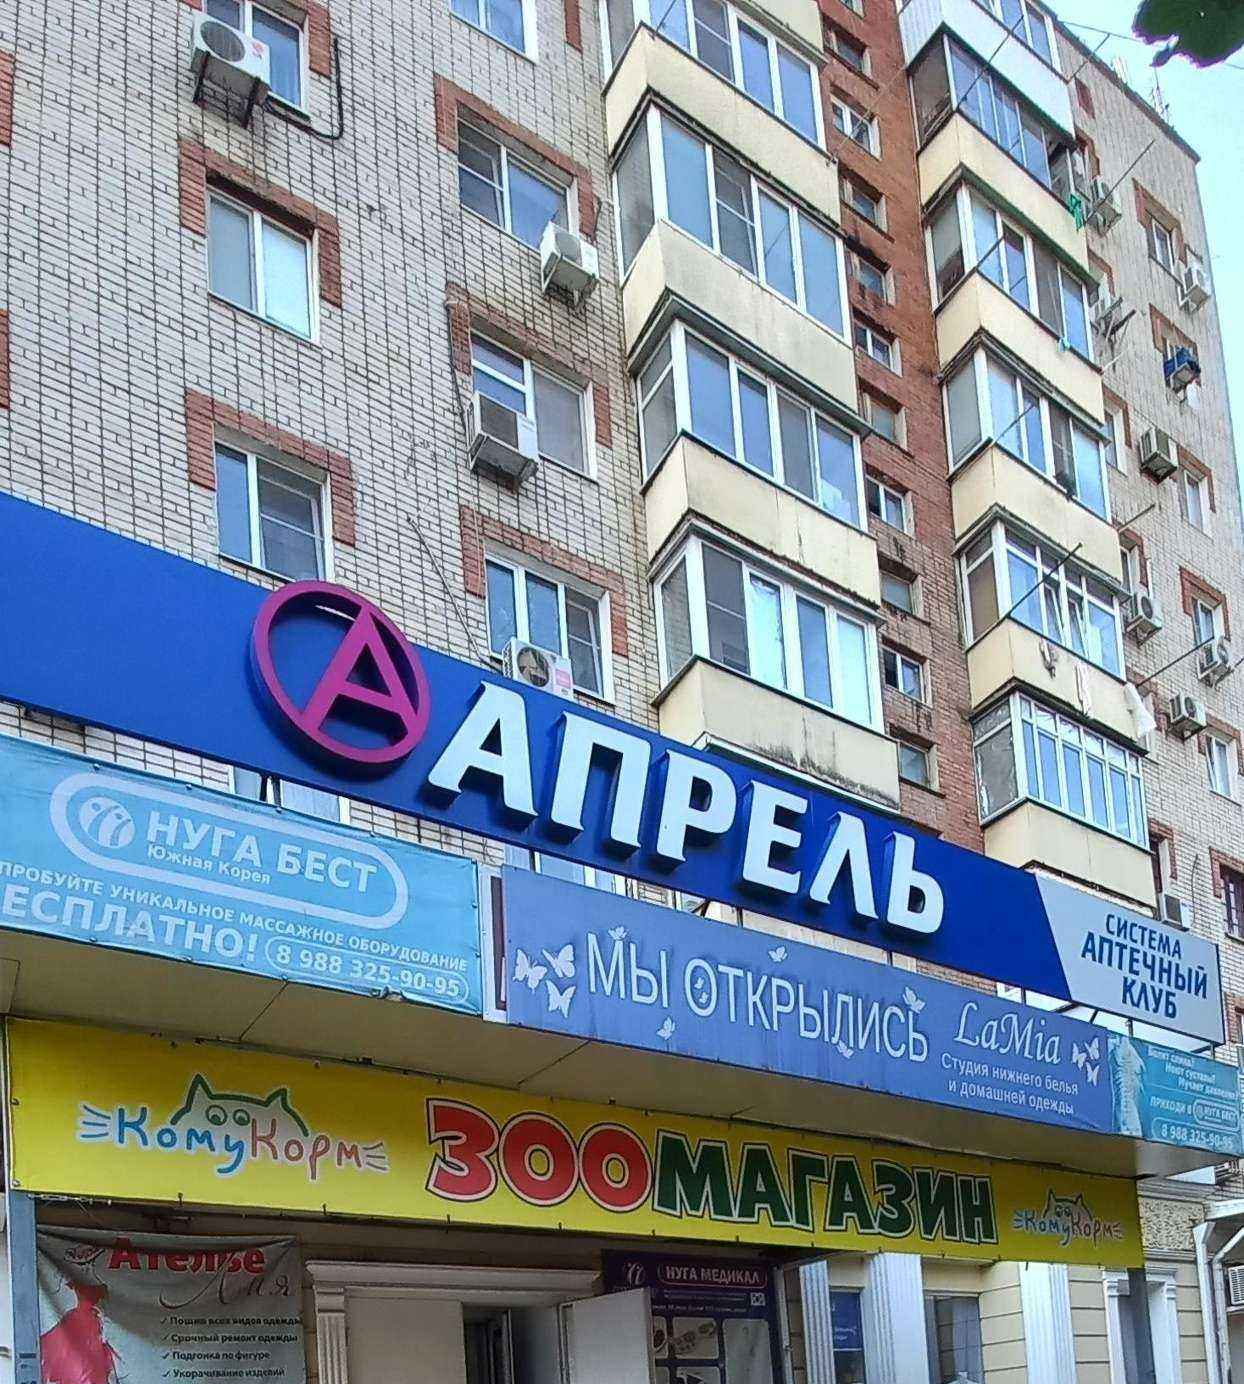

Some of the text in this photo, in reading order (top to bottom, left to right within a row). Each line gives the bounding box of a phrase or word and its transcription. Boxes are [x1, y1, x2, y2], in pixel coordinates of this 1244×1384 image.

[427, 680, 945, 936] АПРЕЛЬ
[147, 810, 378, 893] НУГА БЕСТ
[148, 843, 272, 886] Южная Корея
[110, 884, 236, 921] УНИКАЛЬНОЕ
[240, 913, 344, 945] МАССАЖНОЕ
[349, 935, 468, 972] ОБОРУДОВАНИЕ
[1105, 913, 1182, 960] СИСТЕМА
[275, 944, 461, 998] 8 988 325-90-95
[1081, 931, 1208, 1000] АПТЕЧНЫЙ
[586, 930, 929, 1063] МЫ ОТКРЫЛИСЬ
[1121, 975, 1178, 1019] КЛУБ
[941, 1052, 1079, 1096] Студия нижнего белья
[948, 1079, 1074, 1116] и домашней одежды
[116, 1105, 363, 1181] КомуКорм
[425, 1097, 998, 1245] ЗООМАГАЗИН
[107, 1237, 266, 1274] Ателье
[665, 1264, 761, 1284] НУГА МЕДИКАЛ
[171, 1333, 298, 1344] Срочный ремонт одежды
[172, 1350, 271, 1362] Подгонка по фигуре
[173, 1368, 245, 1379] Укорачивание
